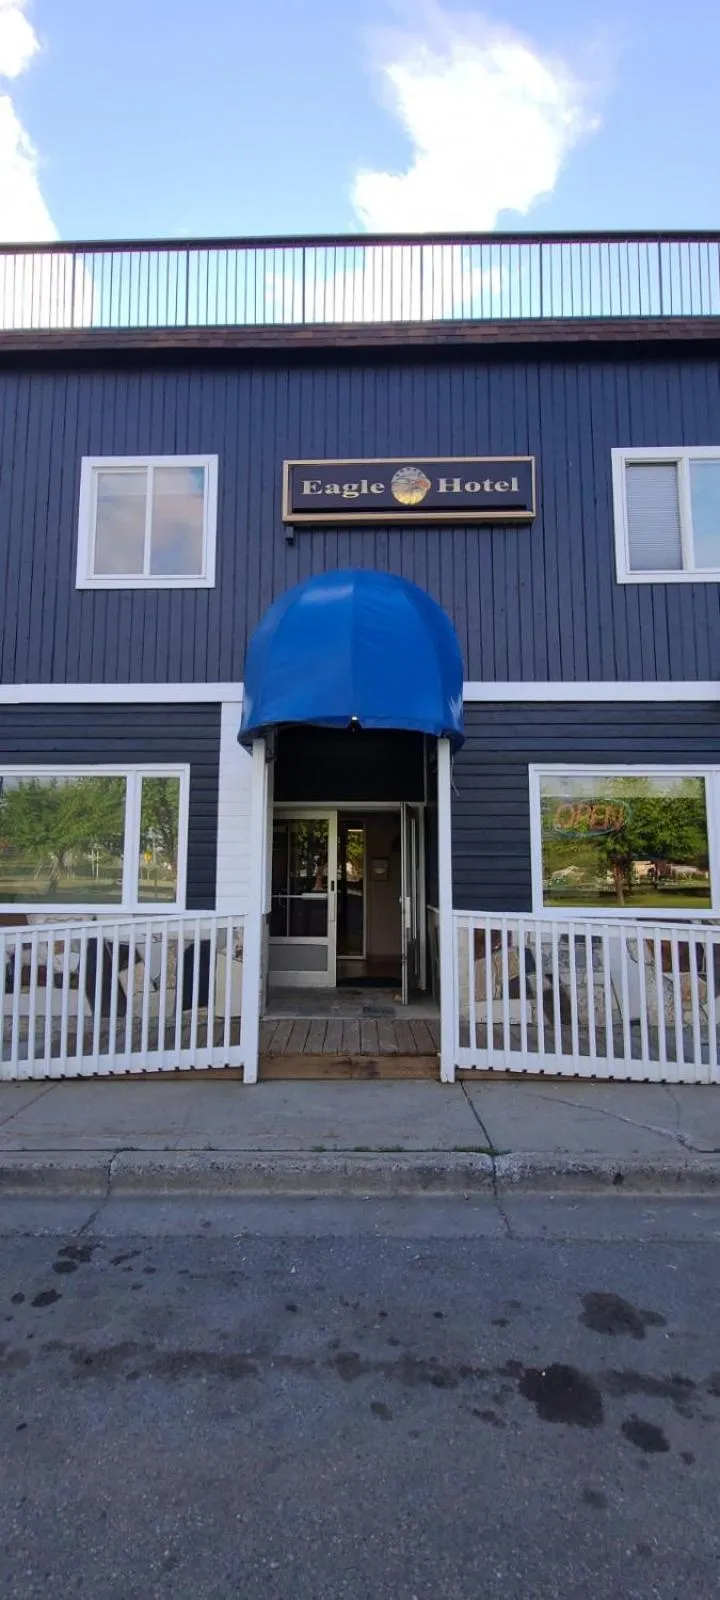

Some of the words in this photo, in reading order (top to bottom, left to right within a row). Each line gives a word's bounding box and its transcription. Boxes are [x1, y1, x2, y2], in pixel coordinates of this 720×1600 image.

[302, 479, 385, 498] Eagle
[437, 477, 520, 493] Hotel
[556, 803, 625, 831] OPEN
